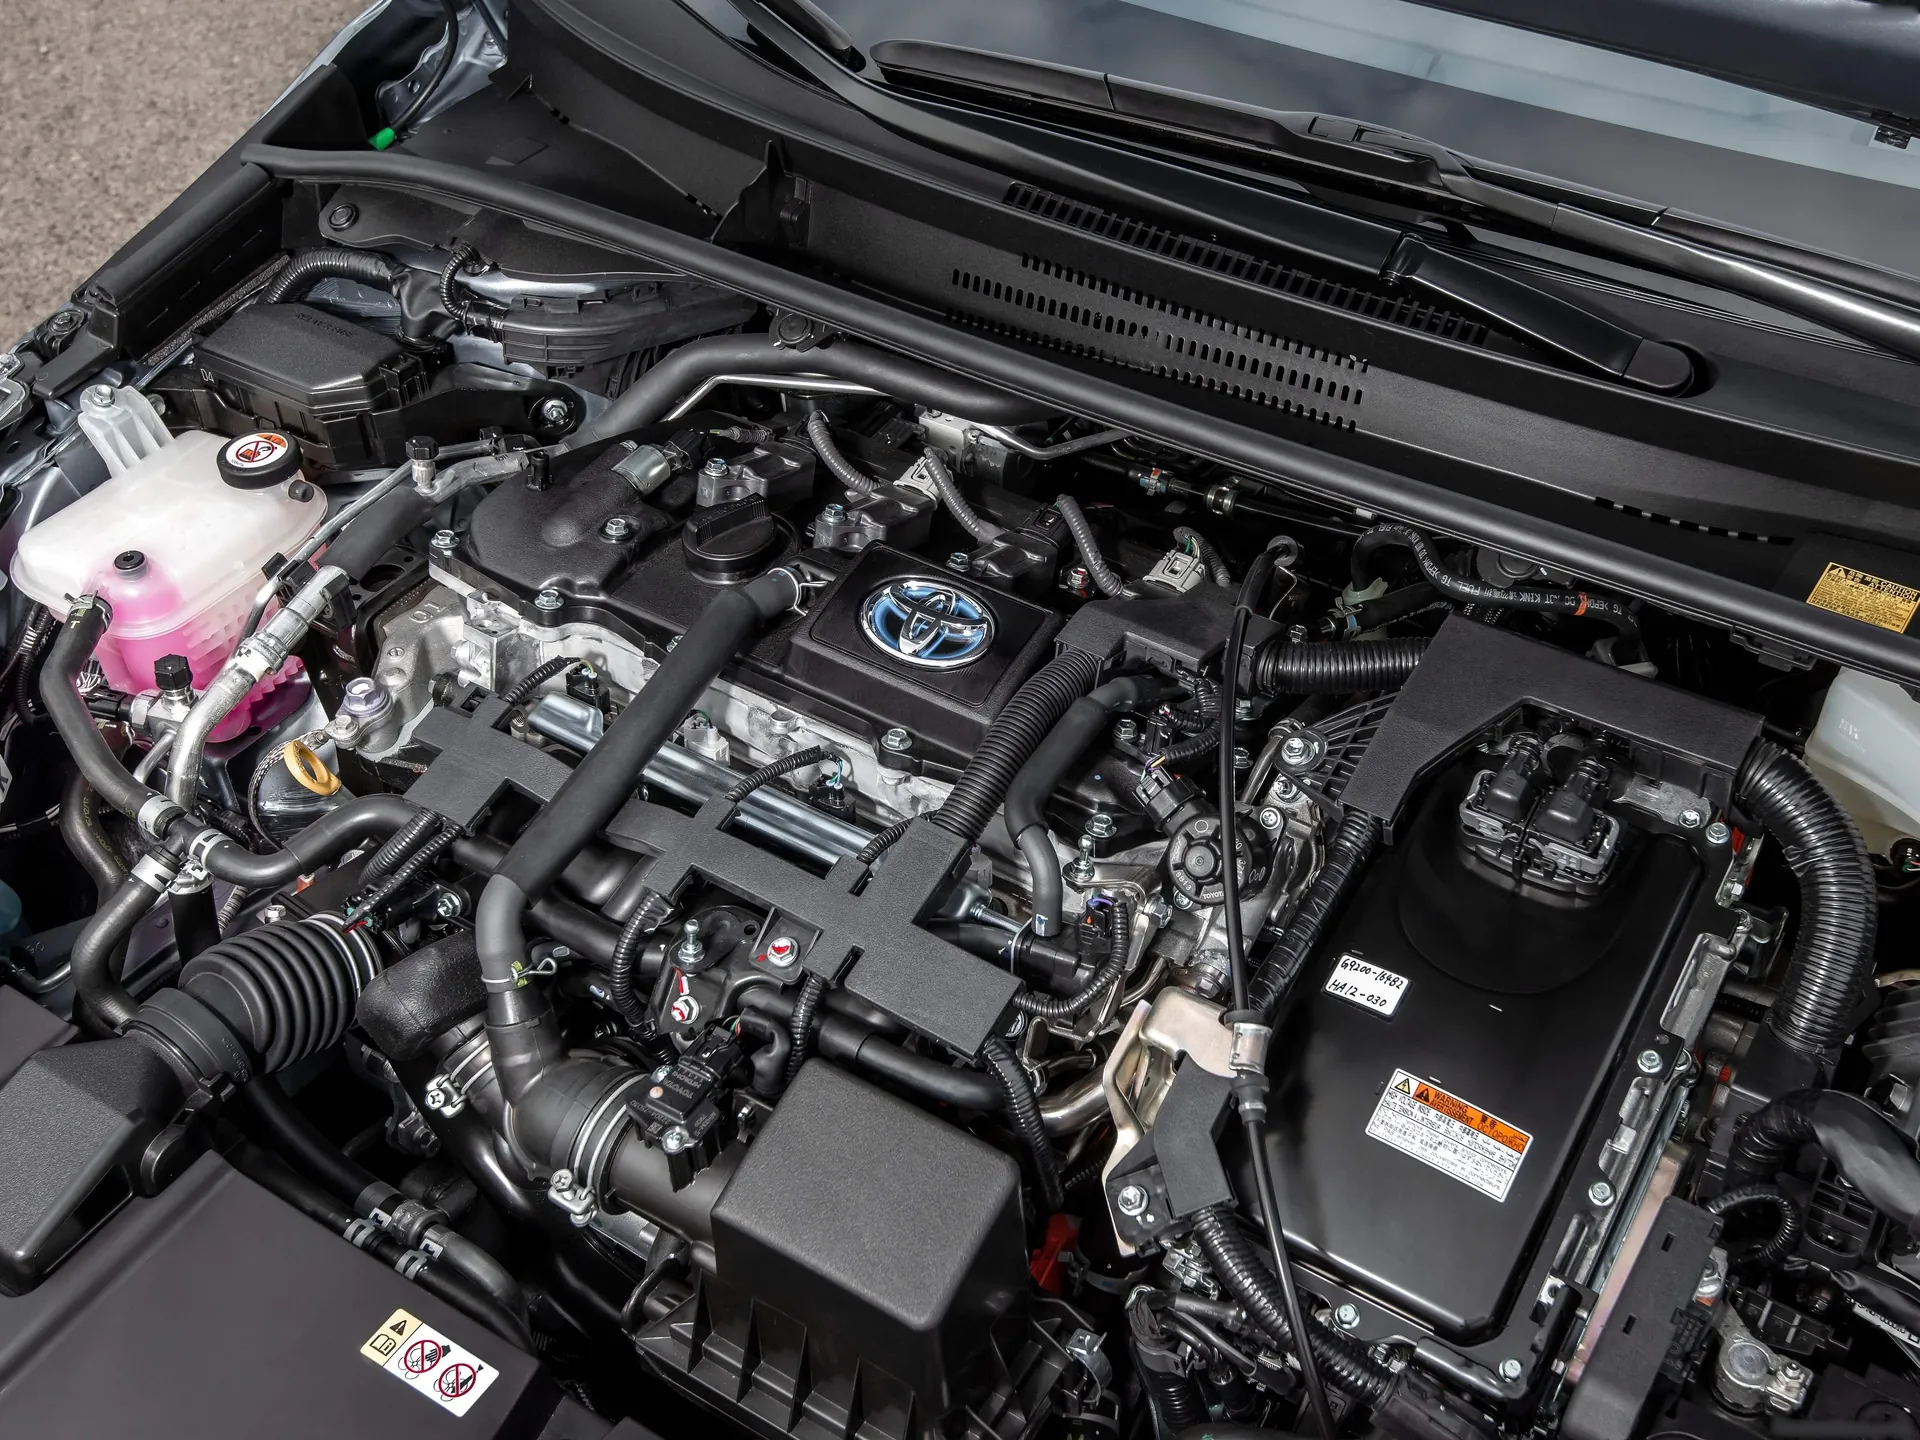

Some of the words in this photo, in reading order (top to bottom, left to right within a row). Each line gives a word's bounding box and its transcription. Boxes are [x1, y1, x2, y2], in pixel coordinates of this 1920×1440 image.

[1868, 582, 1915, 600] ATTENTION
[1880, 582, 1917, 596] CAUTION
[1430, 1098, 1473, 1122] AVERTISSEMENT
[1434, 1091, 1468, 1111] WARNING
